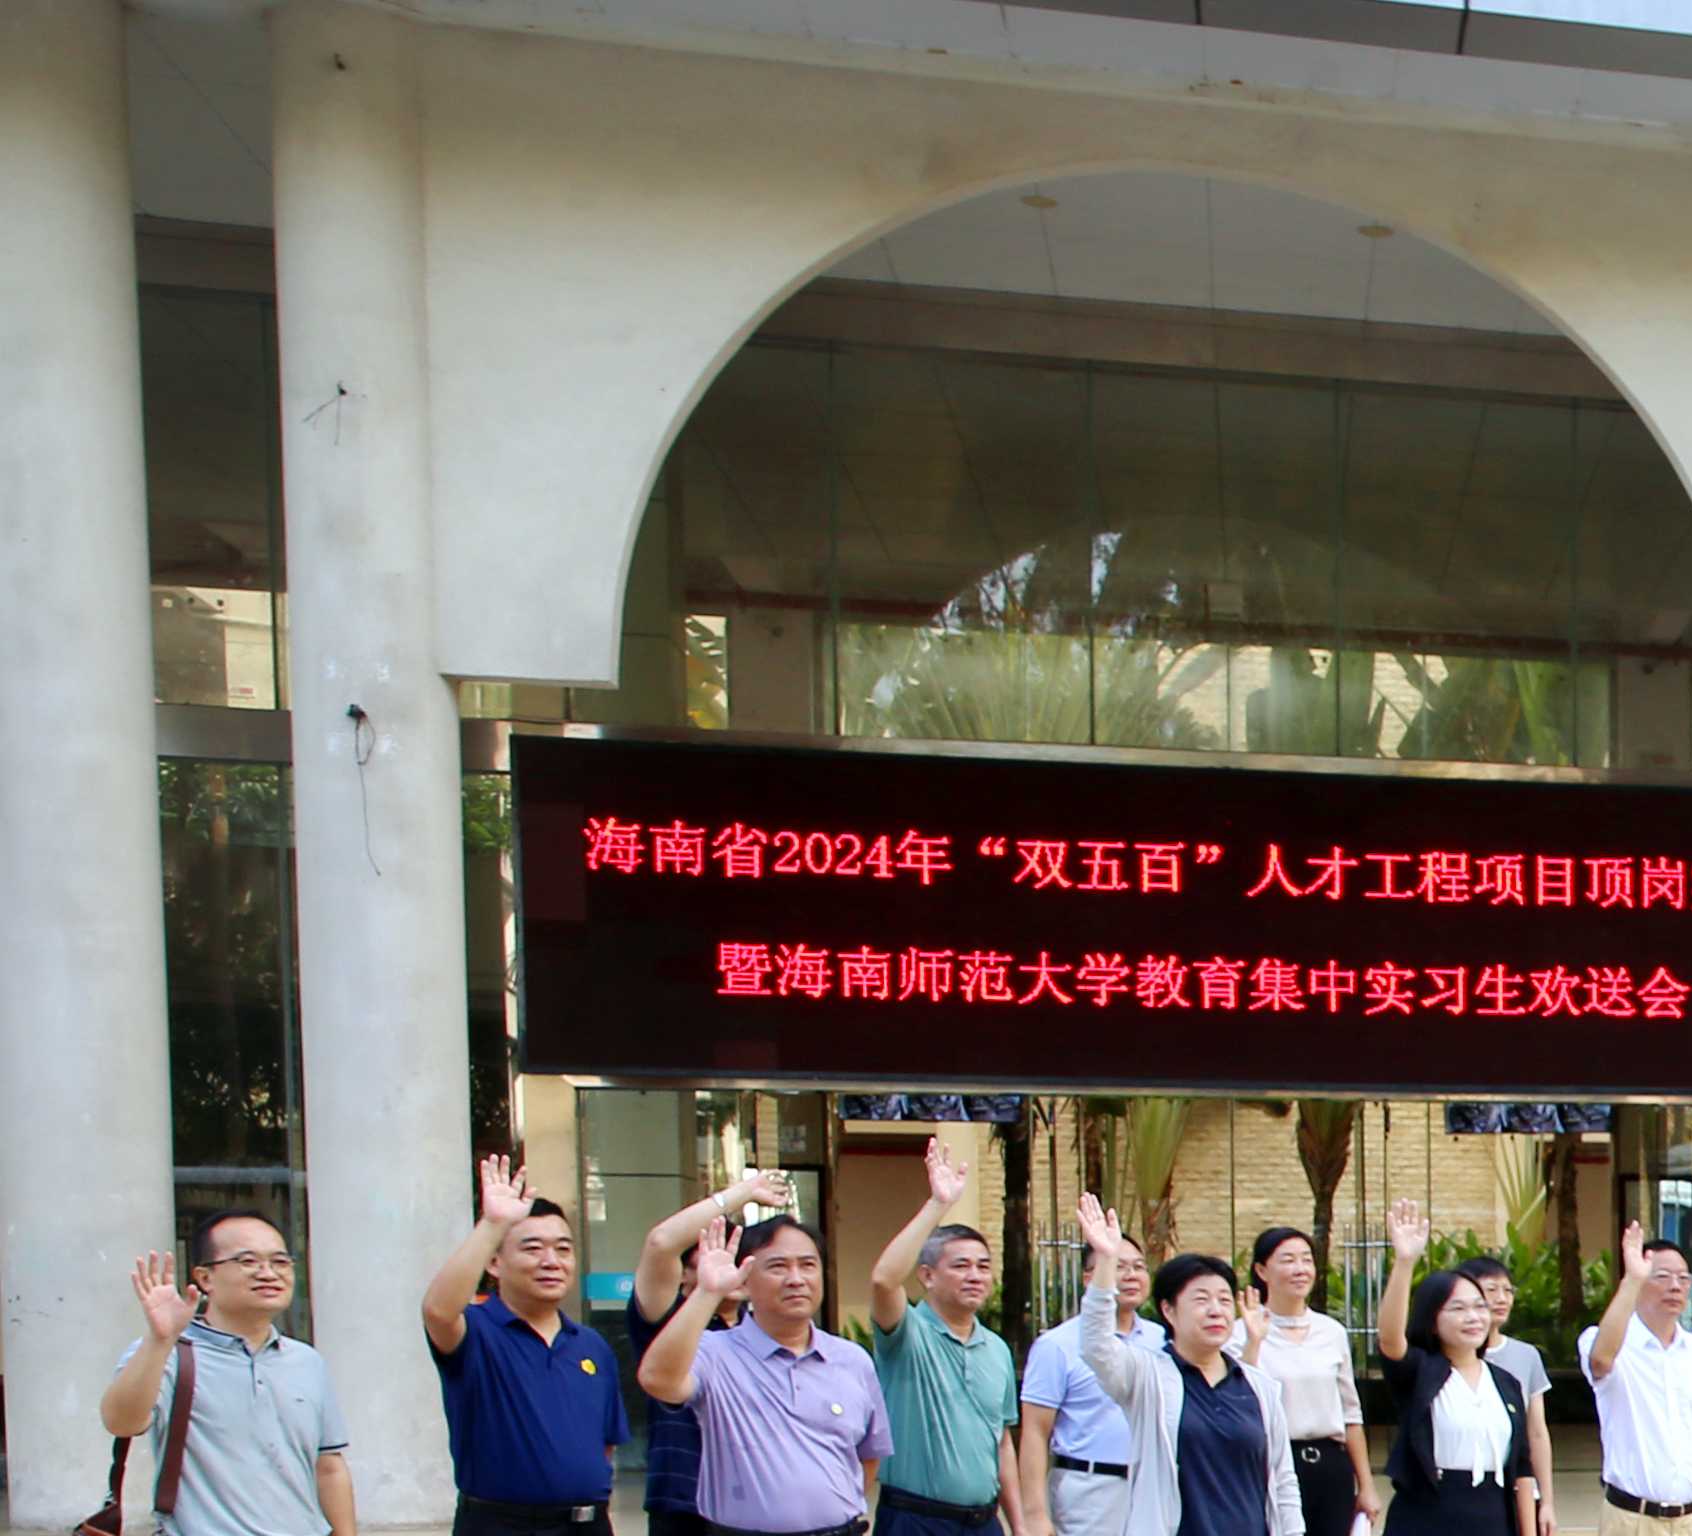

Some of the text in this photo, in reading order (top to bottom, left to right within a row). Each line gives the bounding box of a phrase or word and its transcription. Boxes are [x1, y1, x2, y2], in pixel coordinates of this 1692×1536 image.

[716, 942, 1692, 1020] 暨海南师范大学教育集中实习生欢送会
